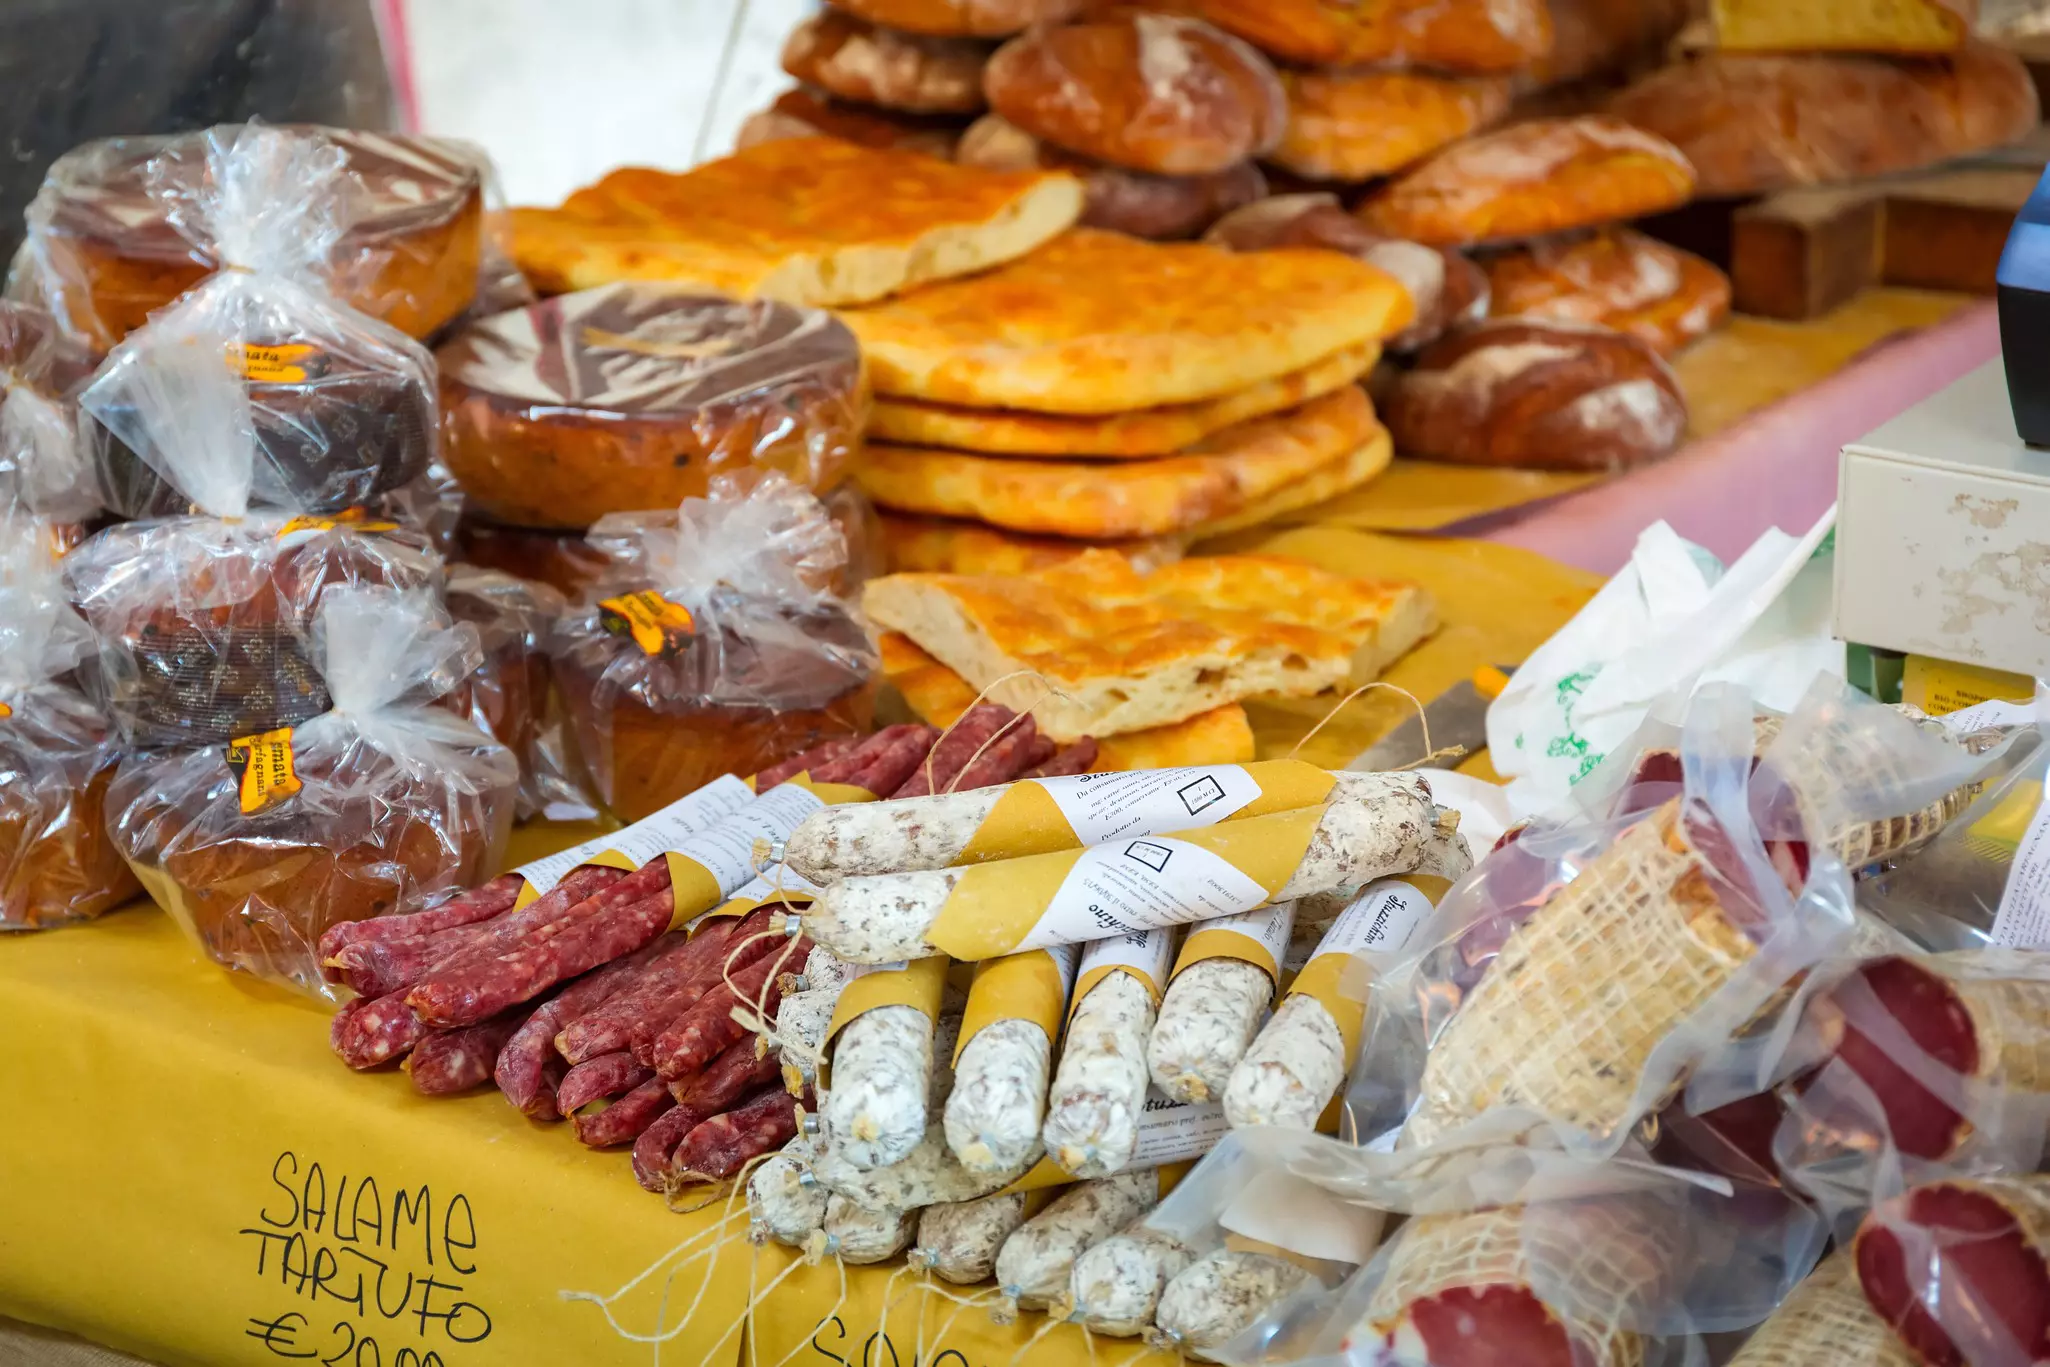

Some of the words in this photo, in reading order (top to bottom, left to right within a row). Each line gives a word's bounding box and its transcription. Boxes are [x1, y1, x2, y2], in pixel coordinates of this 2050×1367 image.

[1363, 893, 1408, 945] Stuzzichino
[260, 1151, 477, 1275] SALAME
[239, 1228, 492, 1343] TARTUFO
